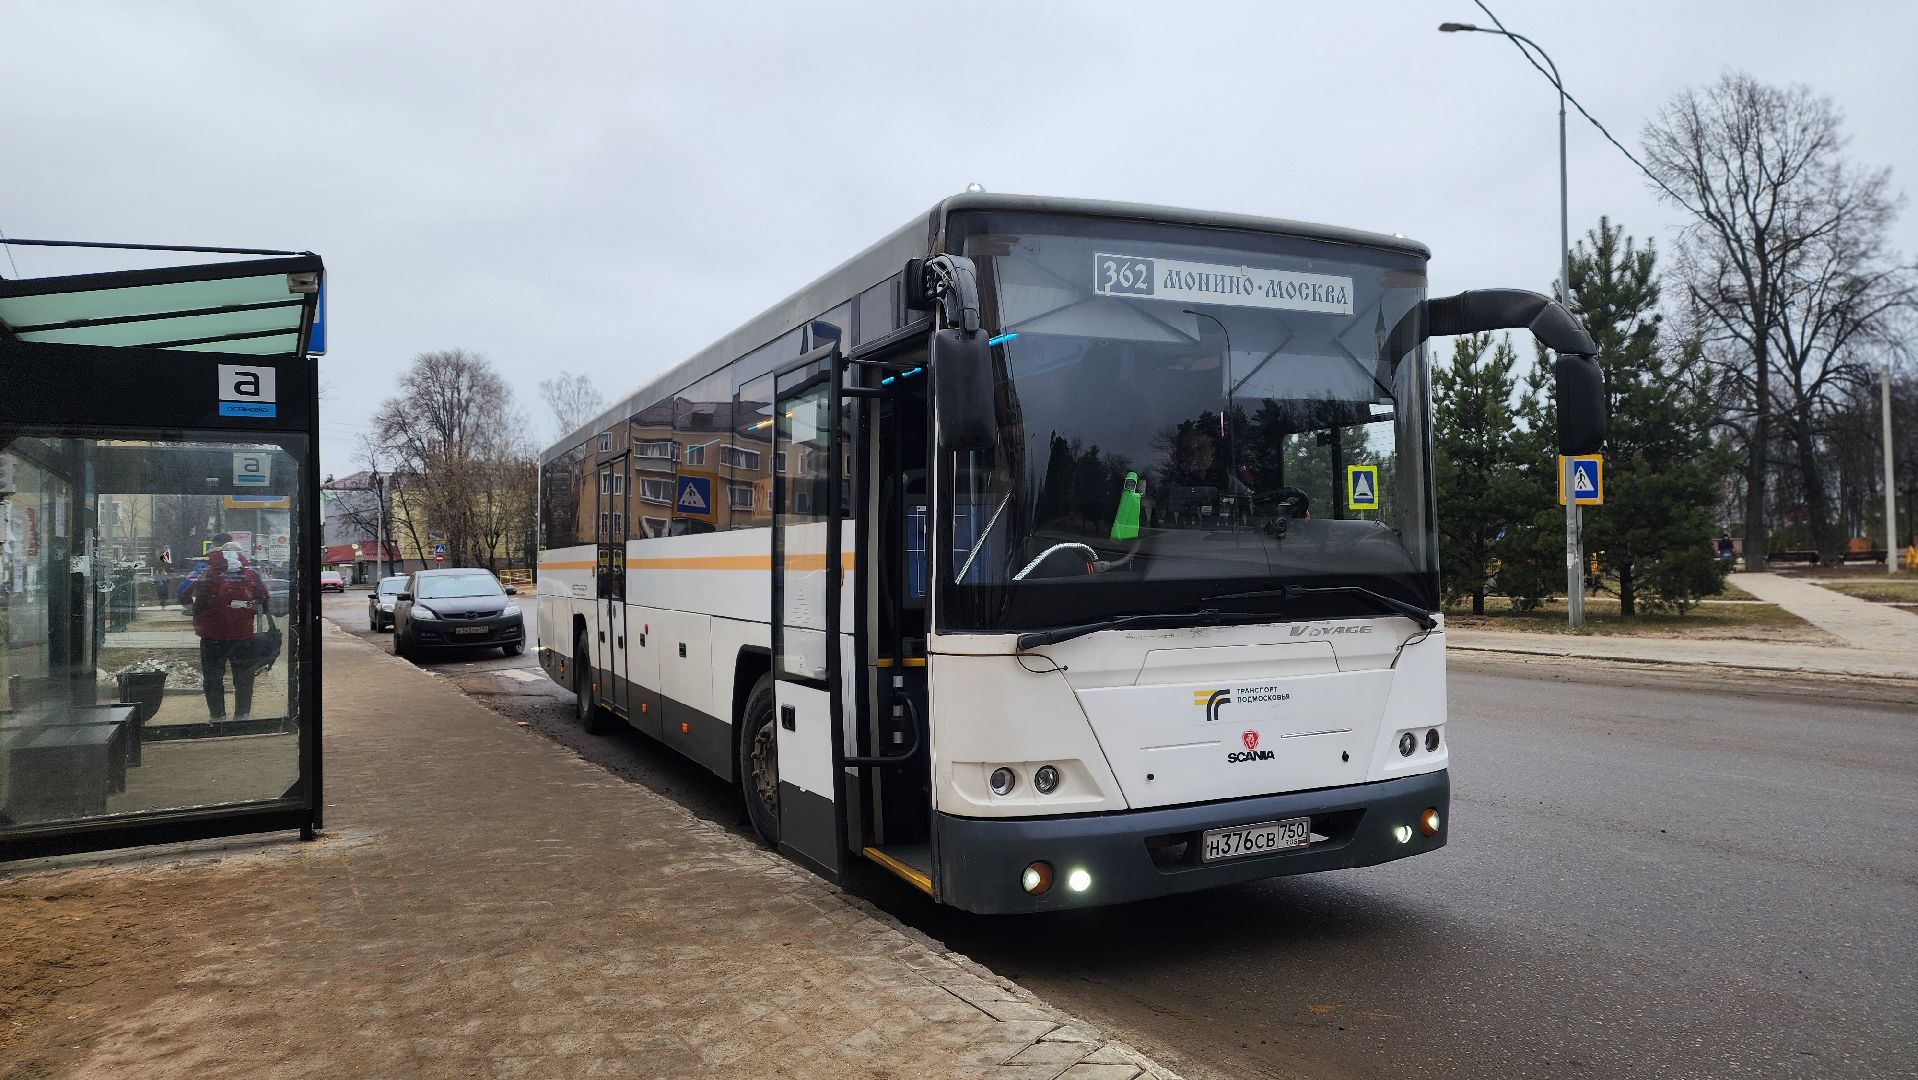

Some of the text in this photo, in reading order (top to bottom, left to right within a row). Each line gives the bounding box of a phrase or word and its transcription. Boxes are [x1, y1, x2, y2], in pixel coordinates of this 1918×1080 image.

[1103, 260, 1148, 290] 362
[1289, 625, 1374, 637] VOYAGE
[1236, 686, 1278, 695] ТРАНСПОРТ
[1236, 693, 1290, 704] ПОДМОСКОВЬЯ
[1227, 750, 1276, 764] SCANIA
[1279, 822, 1305, 841] 750
[1285, 838, 1298, 846] RUS
